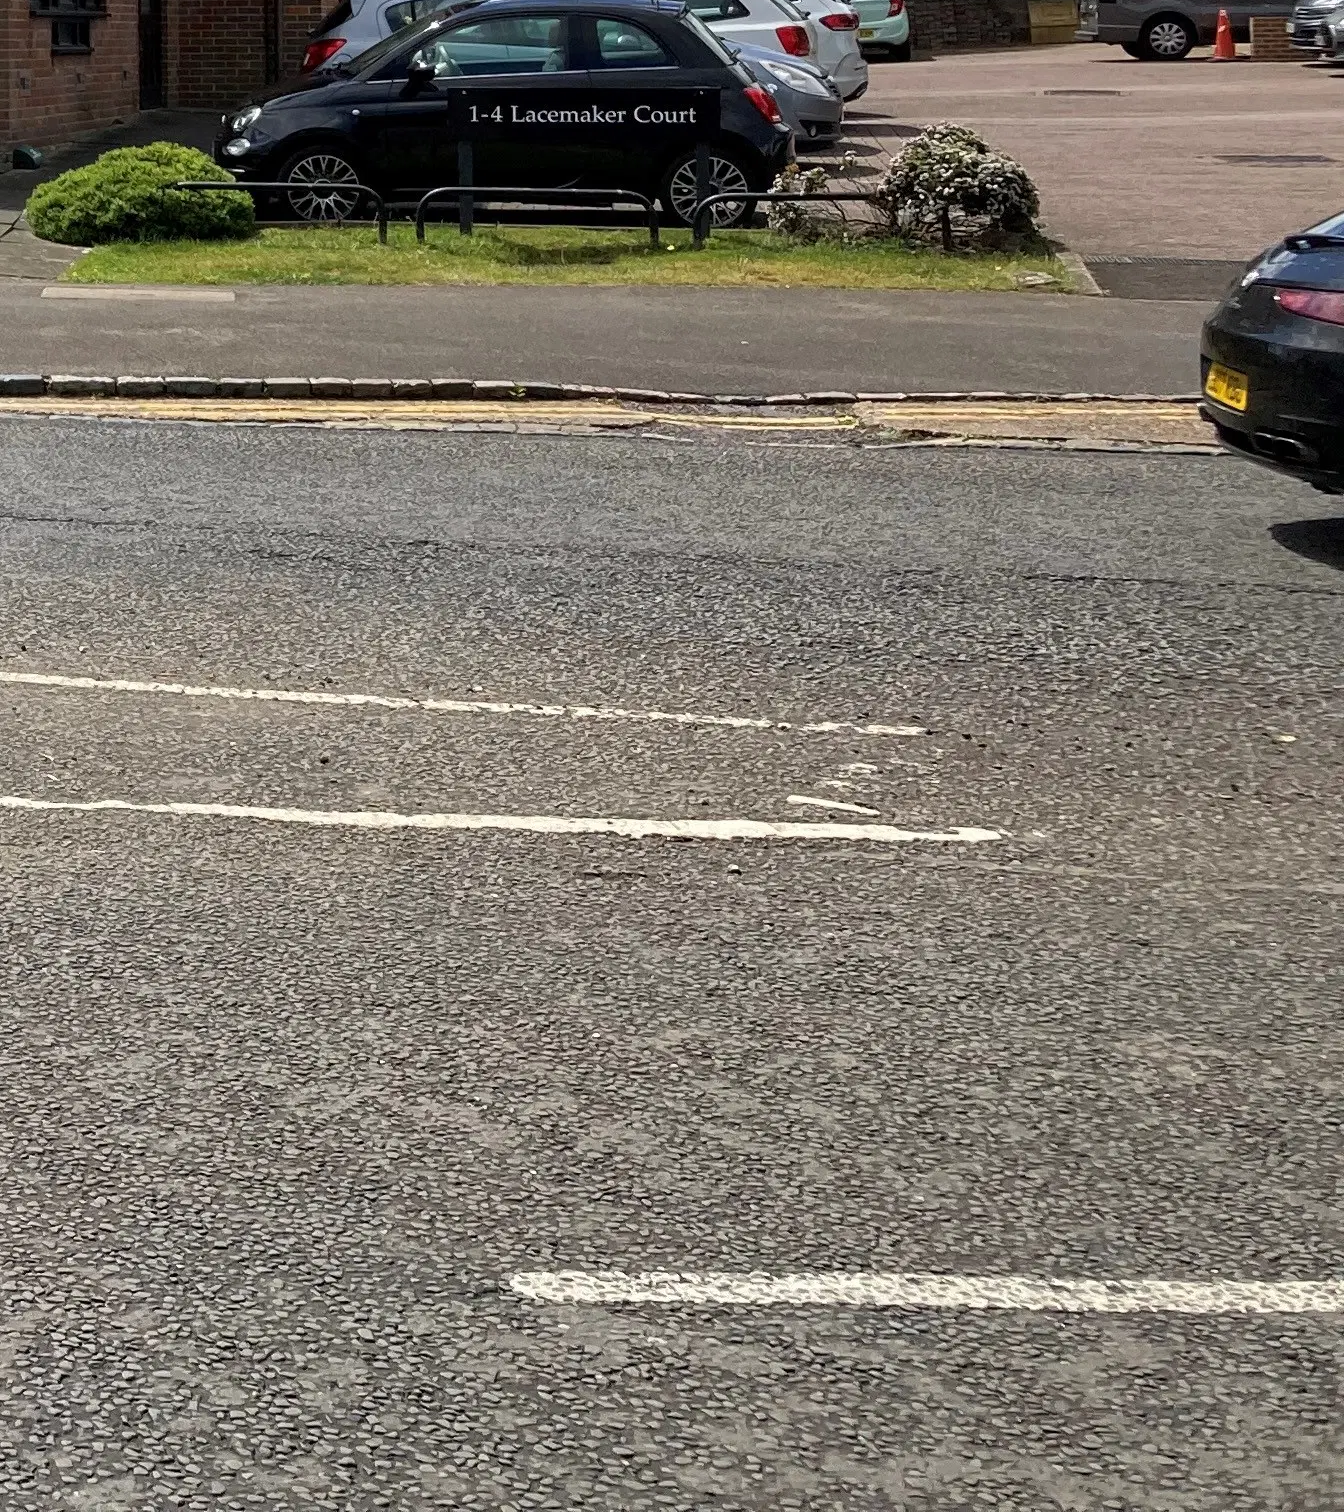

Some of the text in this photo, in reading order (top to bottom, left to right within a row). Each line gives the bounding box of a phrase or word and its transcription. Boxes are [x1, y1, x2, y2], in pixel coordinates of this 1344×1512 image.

[469, 105, 697, 123] 1-4 Lacemaker Court
